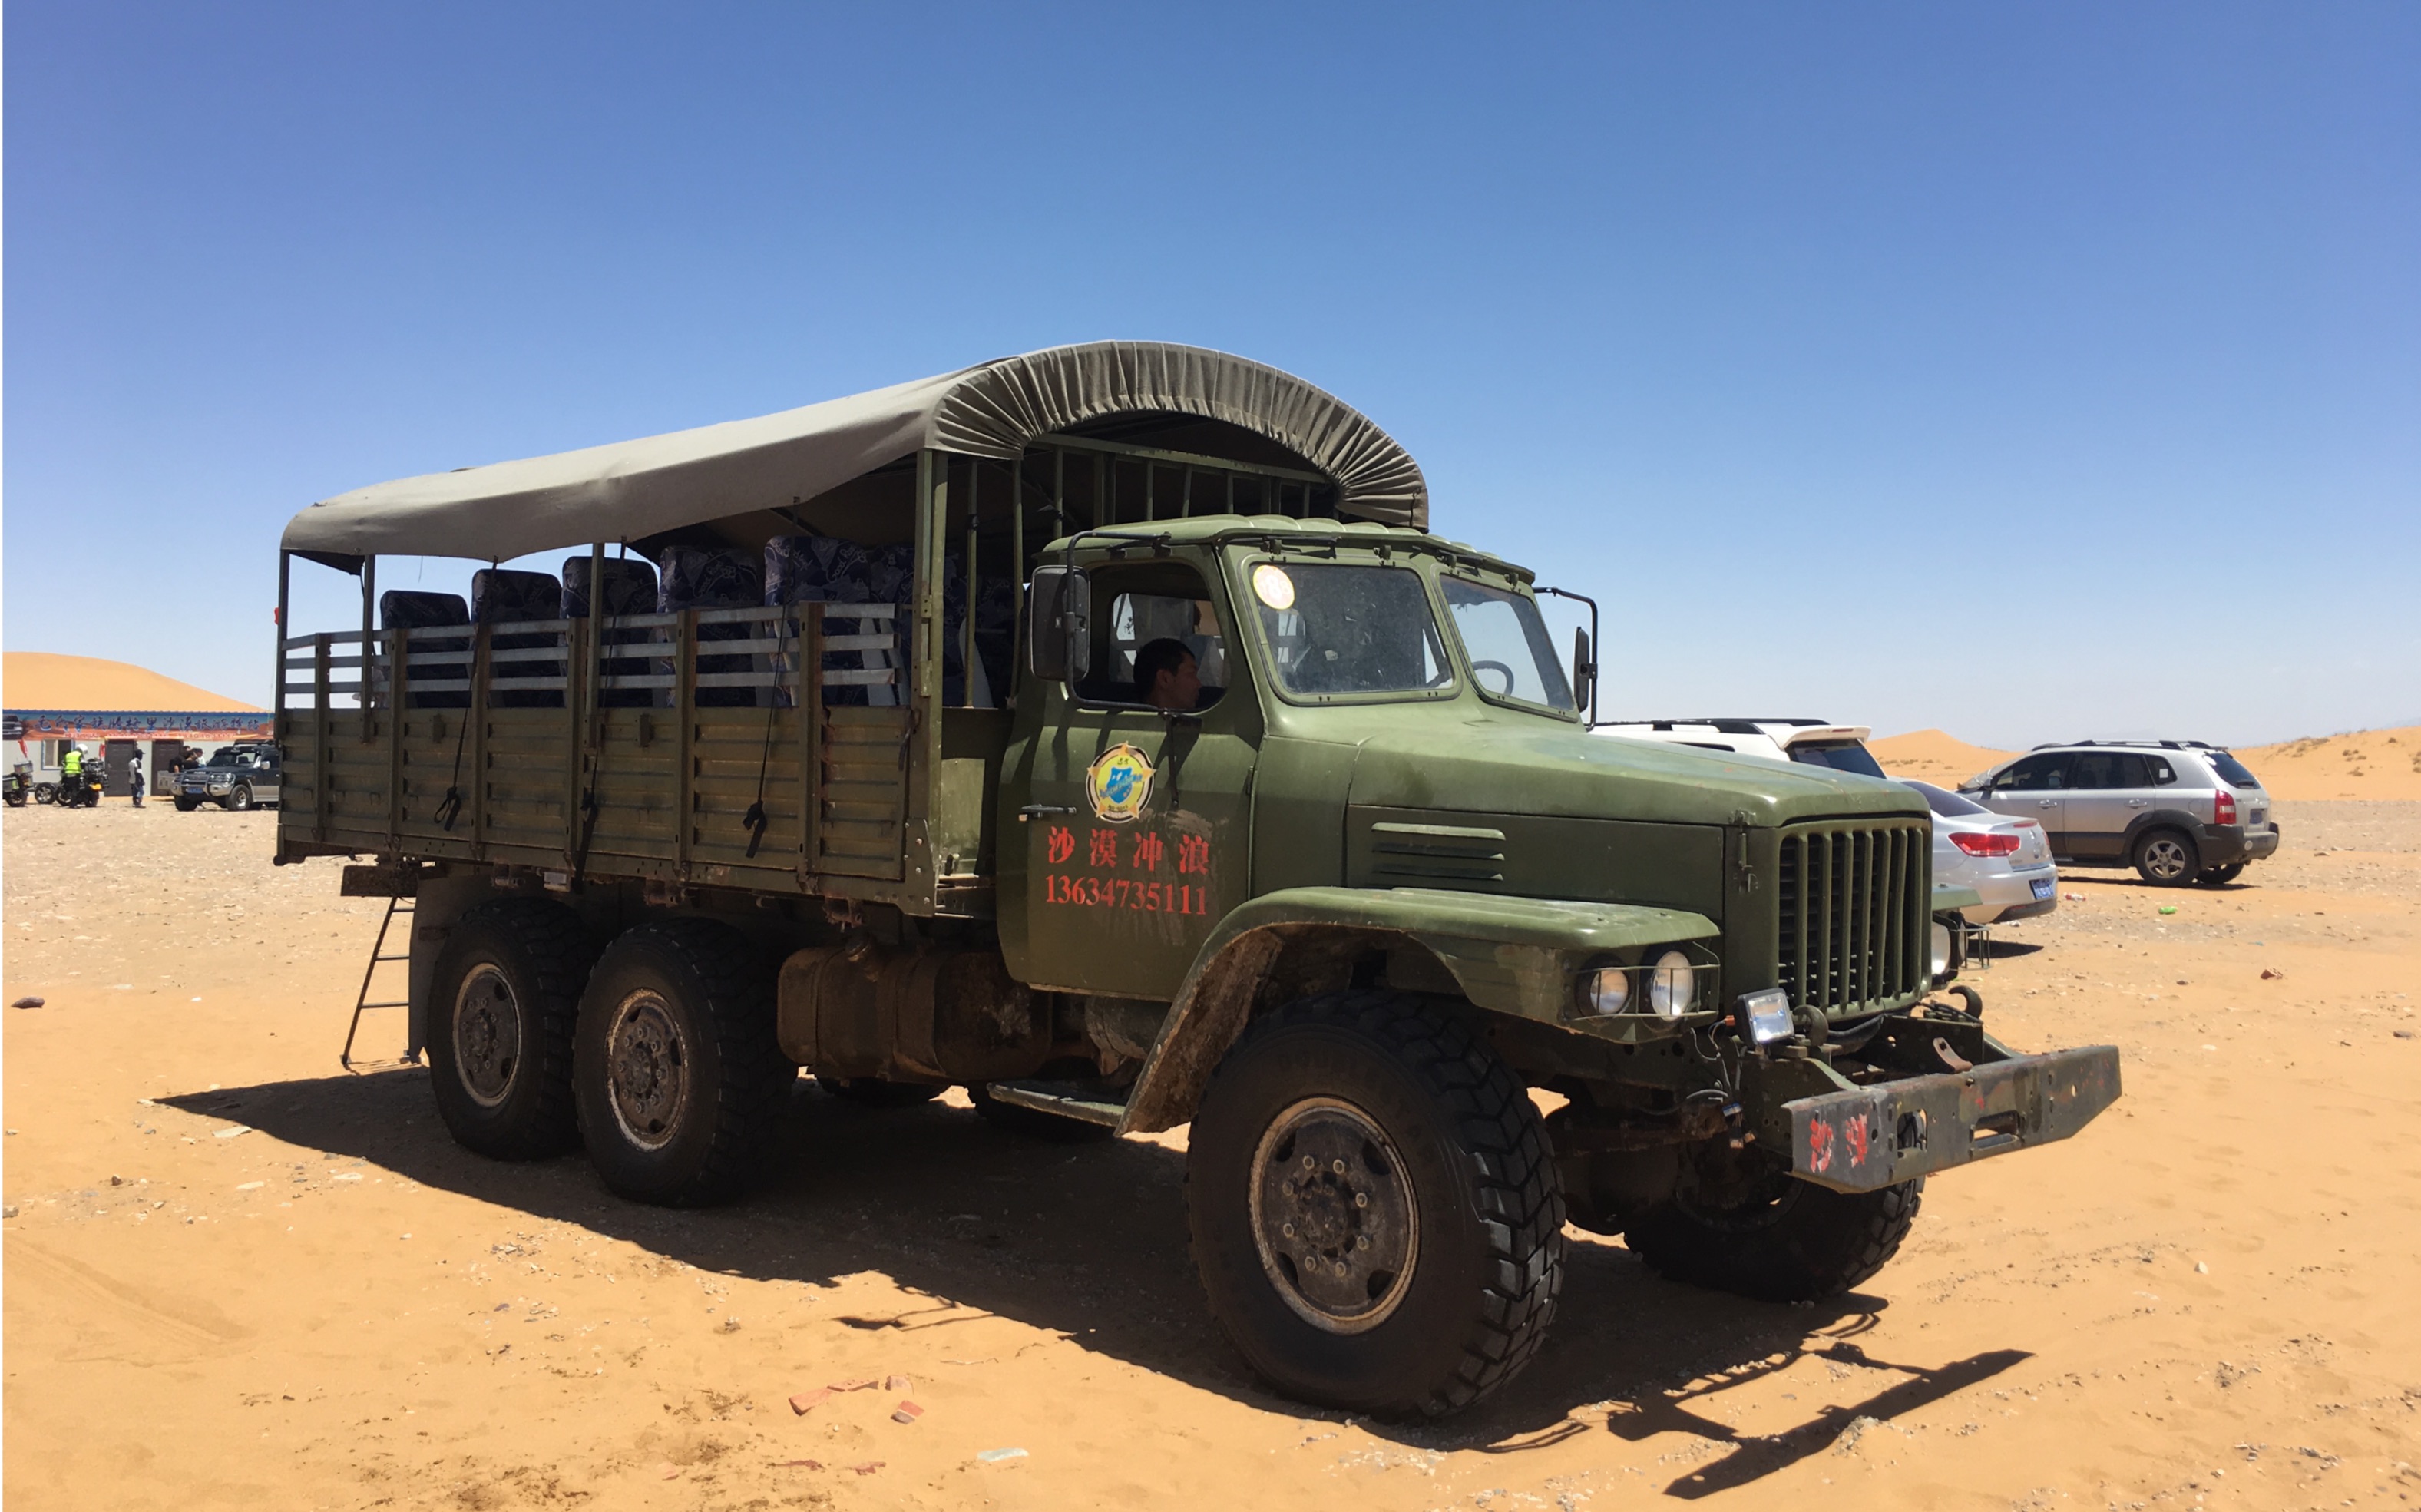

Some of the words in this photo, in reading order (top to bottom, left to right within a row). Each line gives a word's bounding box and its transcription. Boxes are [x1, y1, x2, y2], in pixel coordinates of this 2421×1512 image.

[1047, 825, 1209, 875] 沙漠冲浪
[1045, 874, 1206, 915] 13634735111
